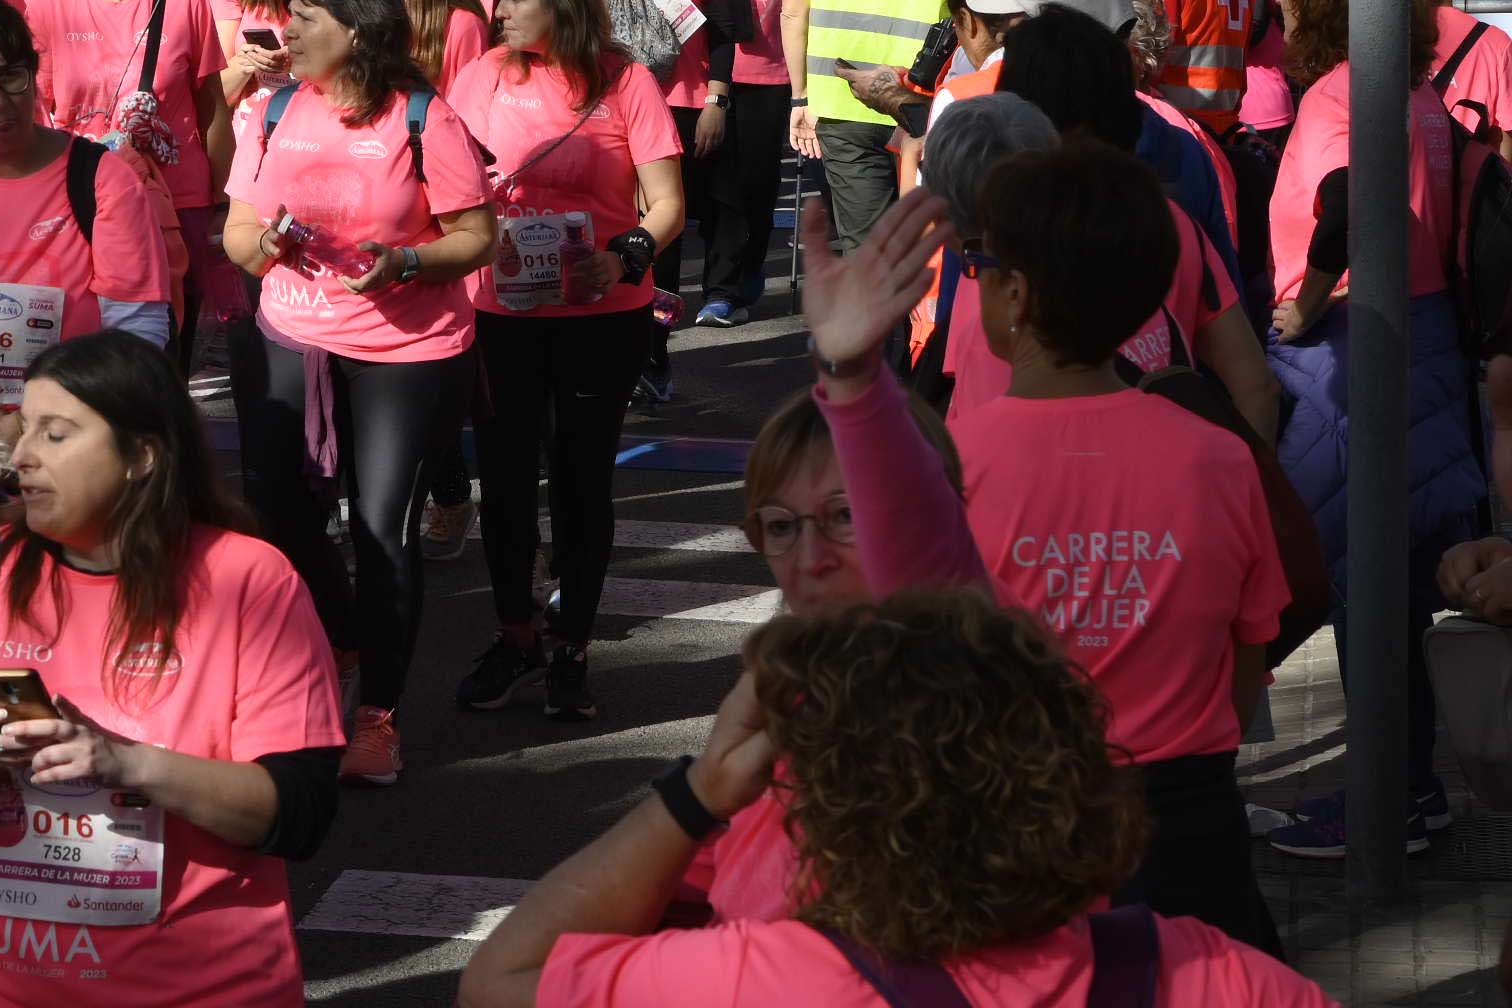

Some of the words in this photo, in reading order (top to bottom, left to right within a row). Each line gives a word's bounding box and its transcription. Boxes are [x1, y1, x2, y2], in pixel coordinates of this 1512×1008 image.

[501, 93, 542, 109] OYSHO
[279, 138, 320, 153] OYSHO
[524, 252, 560, 269] 016
[269, 276, 333, 308] SUMA
[1012, 529, 1182, 568] CARRERA
[1046, 566, 1092, 598] DE
[1103, 564, 1148, 596] LA
[1041, 598, 1152, 631] MUJER
[1077, 635, 1109, 648] 2023
[33, 809, 95, 839] 016
[43, 844, 82, 863] 7528
[41, 868, 56, 880] DE
[57, 870, 71, 881] LA
[73, 872, 110, 885] MUJER
[114, 875, 142, 886] 2023
[83, 896, 145, 913] Santander
[79, 968, 108, 980] 2023
